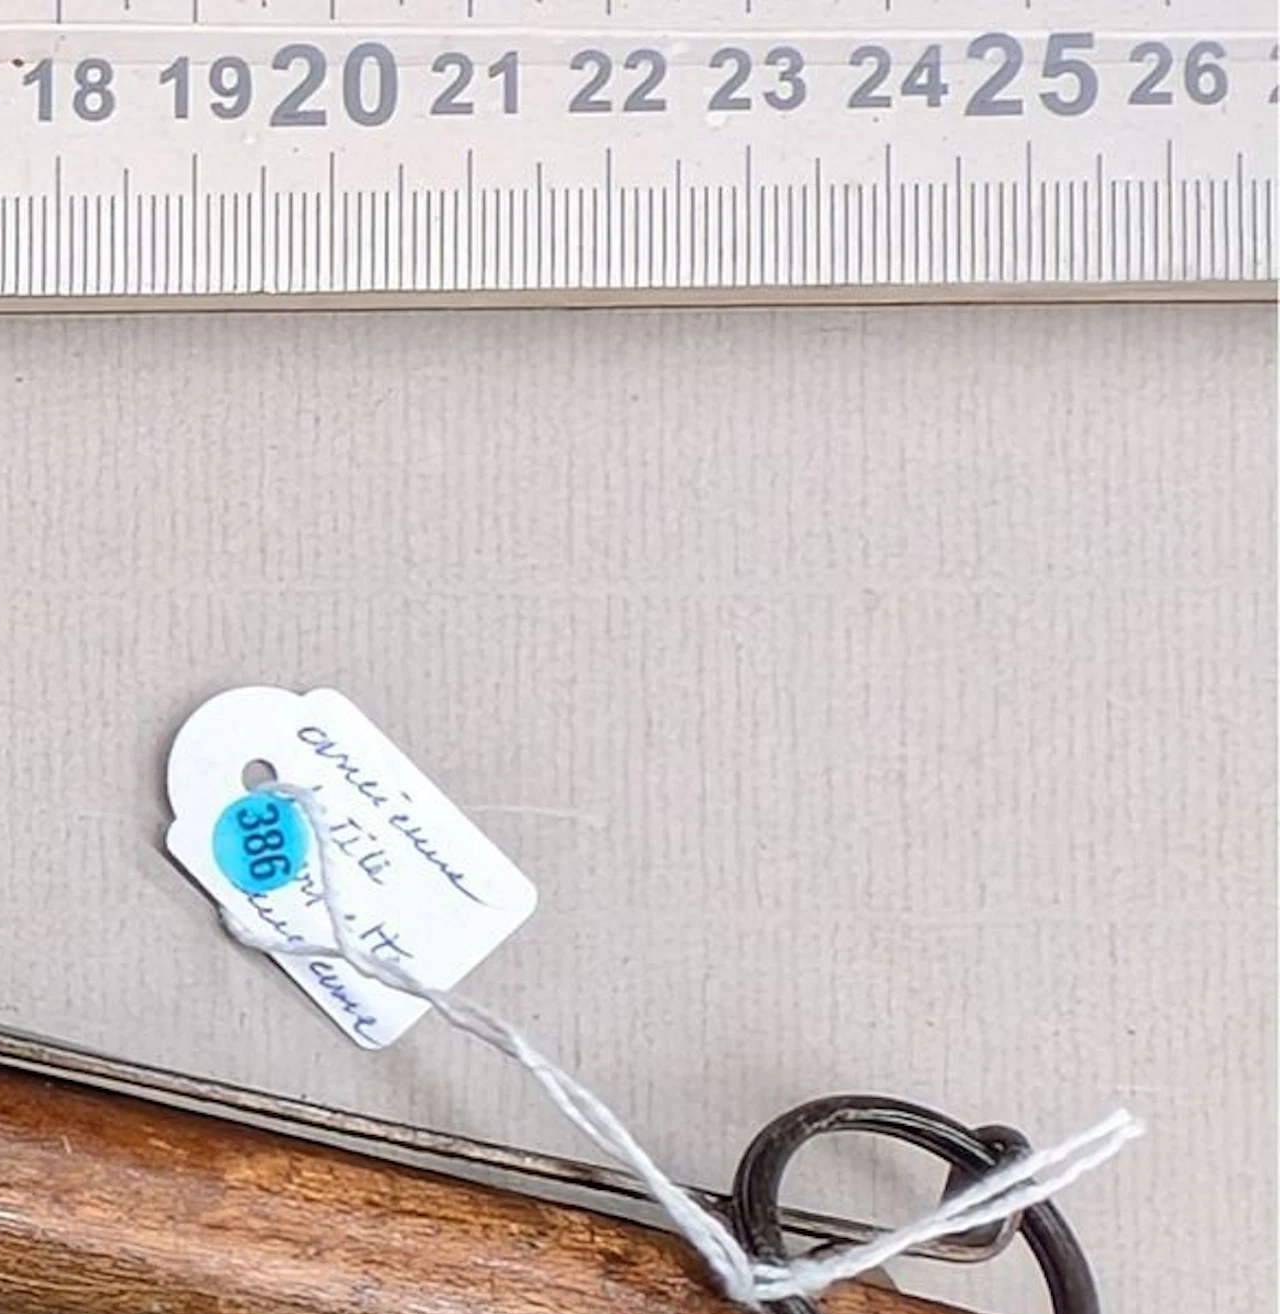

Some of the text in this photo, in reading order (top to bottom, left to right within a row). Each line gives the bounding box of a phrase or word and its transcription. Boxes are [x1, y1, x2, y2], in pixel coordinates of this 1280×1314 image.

[23, 59, 114, 121] 18
[160, 57, 251, 118] 19
[270, 43, 397, 126] 20
[431, 52, 517, 114] 21
[569, 50, 666, 112] 22
[709, 48, 805, 110] 23
[848, 45, 948, 108] 24
[965, 33, 1097, 116] 25
[1129, 42, 1227, 104] 26
[238, 804, 291, 881] 386
